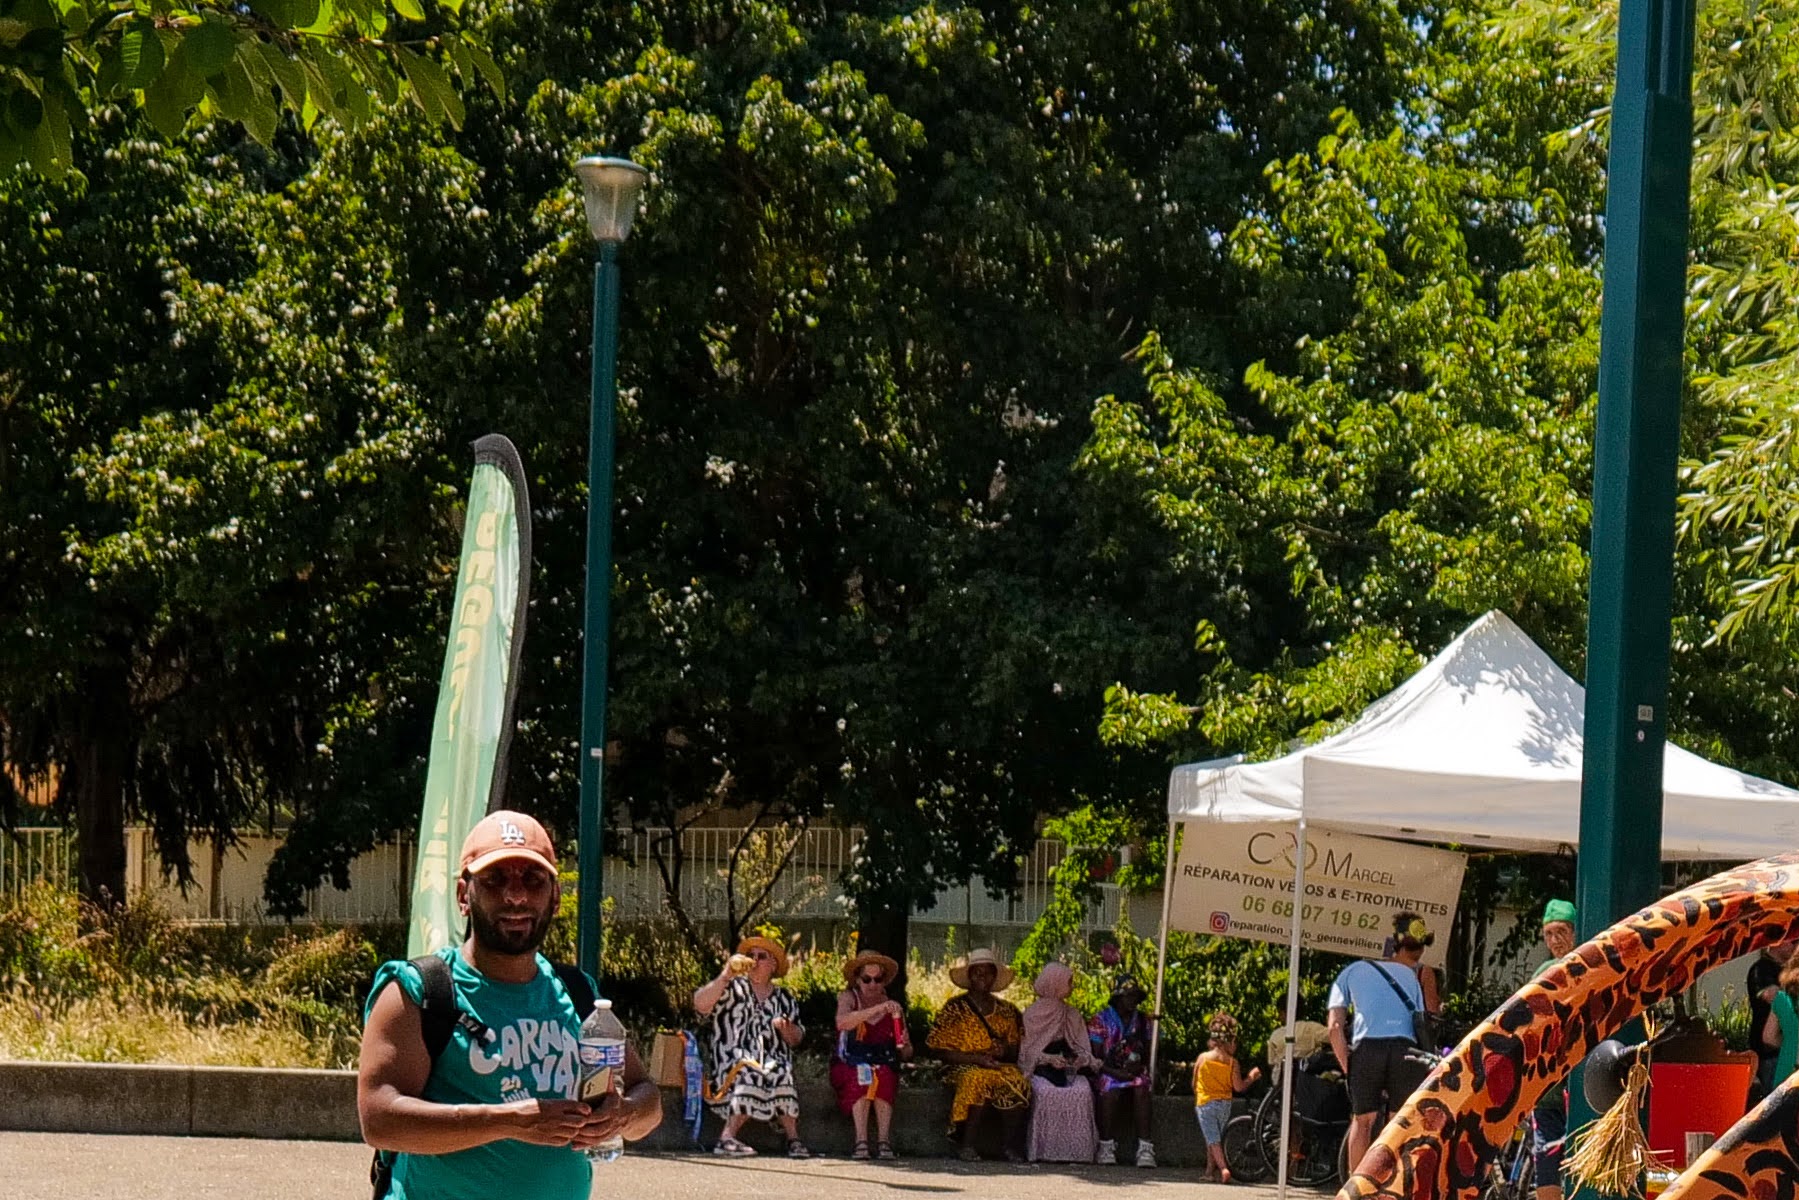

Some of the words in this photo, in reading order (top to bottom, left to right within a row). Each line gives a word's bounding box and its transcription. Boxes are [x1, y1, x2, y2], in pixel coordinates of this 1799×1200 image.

[500, 820, 526, 846] LA
[1183, 864, 1275, 889] RÉPARATION
[1279, 878, 1325, 897] VÉOS
[1327, 889, 1337, 899] &
[1341, 889, 1449, 916] E-TROTINETTES
[1242, 895, 1267, 914] 06
[1271, 900, 1295, 918] 68
[1302, 904, 1325, 923] 07
[1331, 909, 1353, 926] 19
[1357, 913, 1381, 931] 62
[531, 1055, 581, 1101] VA
